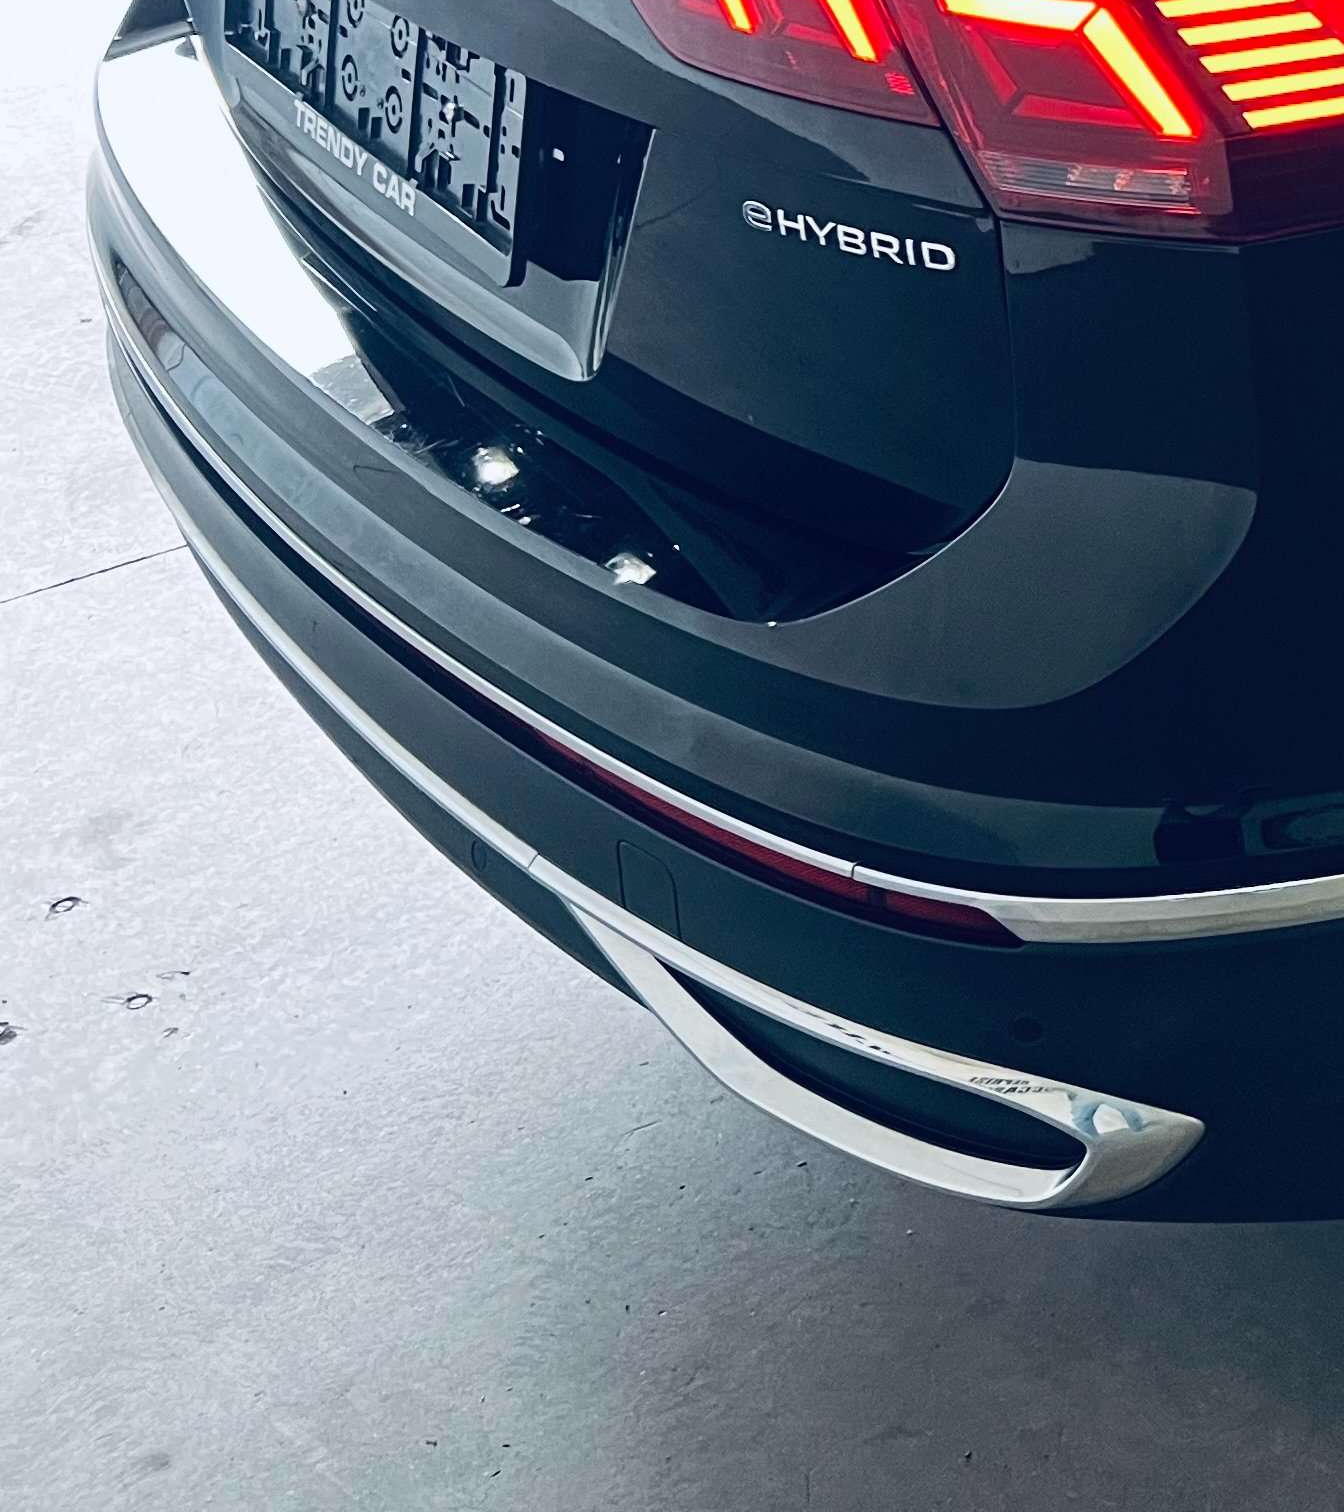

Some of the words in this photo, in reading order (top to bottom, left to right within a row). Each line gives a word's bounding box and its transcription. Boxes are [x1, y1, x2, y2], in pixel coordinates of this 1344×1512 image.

[294, 99, 367, 176] TRENDY
[373, 162, 416, 216] CAR
[742, 200, 956, 271] eHYBRID
